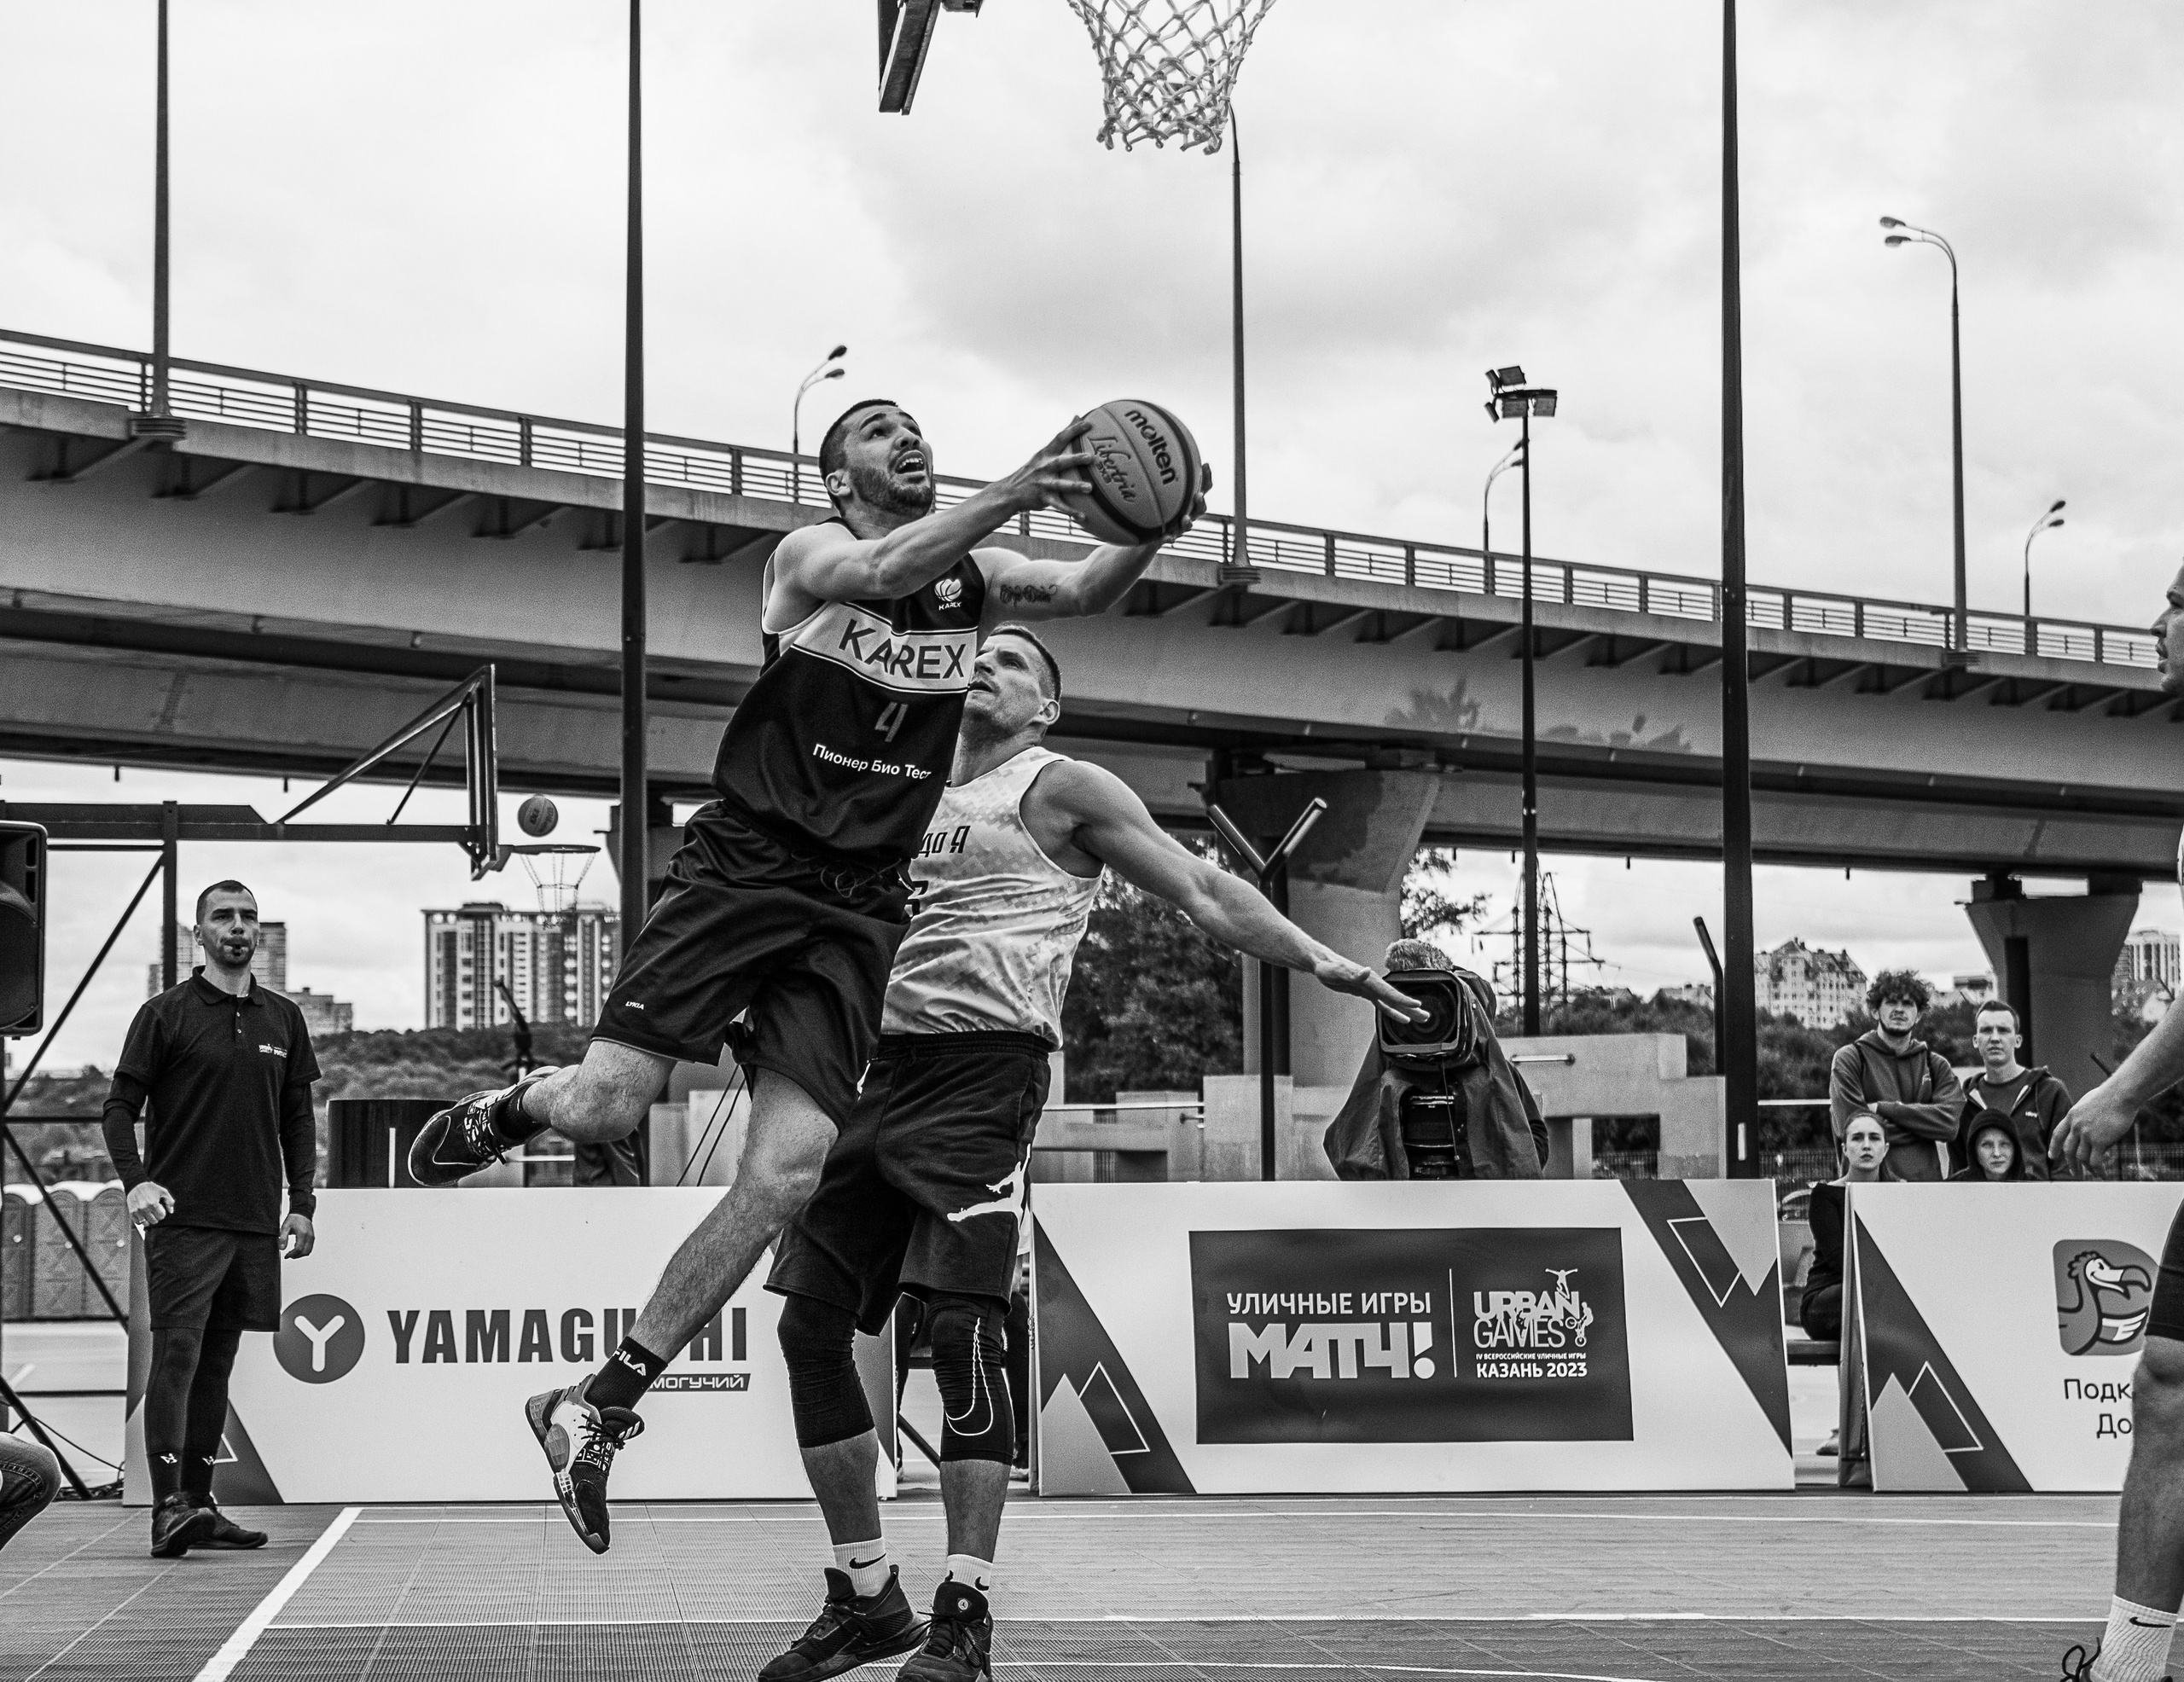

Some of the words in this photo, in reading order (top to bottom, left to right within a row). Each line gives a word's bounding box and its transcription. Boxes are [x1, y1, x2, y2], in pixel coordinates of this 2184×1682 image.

[1124, 410, 1176, 485] molten
[938, 601, 961, 611] KAREX
[839, 618, 967, 679] KAREX
[874, 701, 909, 743] 4
[812, 743, 868, 772] Пионер
[871, 760, 900, 775] Био
[904, 764, 932, 780] Тест
[950, 826, 971, 854] Я
[1226, 1292, 1353, 1314] УЛИЧНЫЕ
[1361, 1291, 1431, 1314] ИГРЫ
[1473, 1290, 1580, 1320] URBAN
[386, 1308, 746, 1364] YAMAGUHI
[1473, 1318, 1565, 1348] GAMES
[1228, 1322, 1436, 1379] МАТЧ!
[1476, 1363, 1543, 1378] КАЗАНЬ
[1547, 1362, 1588, 1378] 2023
[2064, 1378, 2133, 1403] Подк
[2096, 1413, 2133, 1439] До
